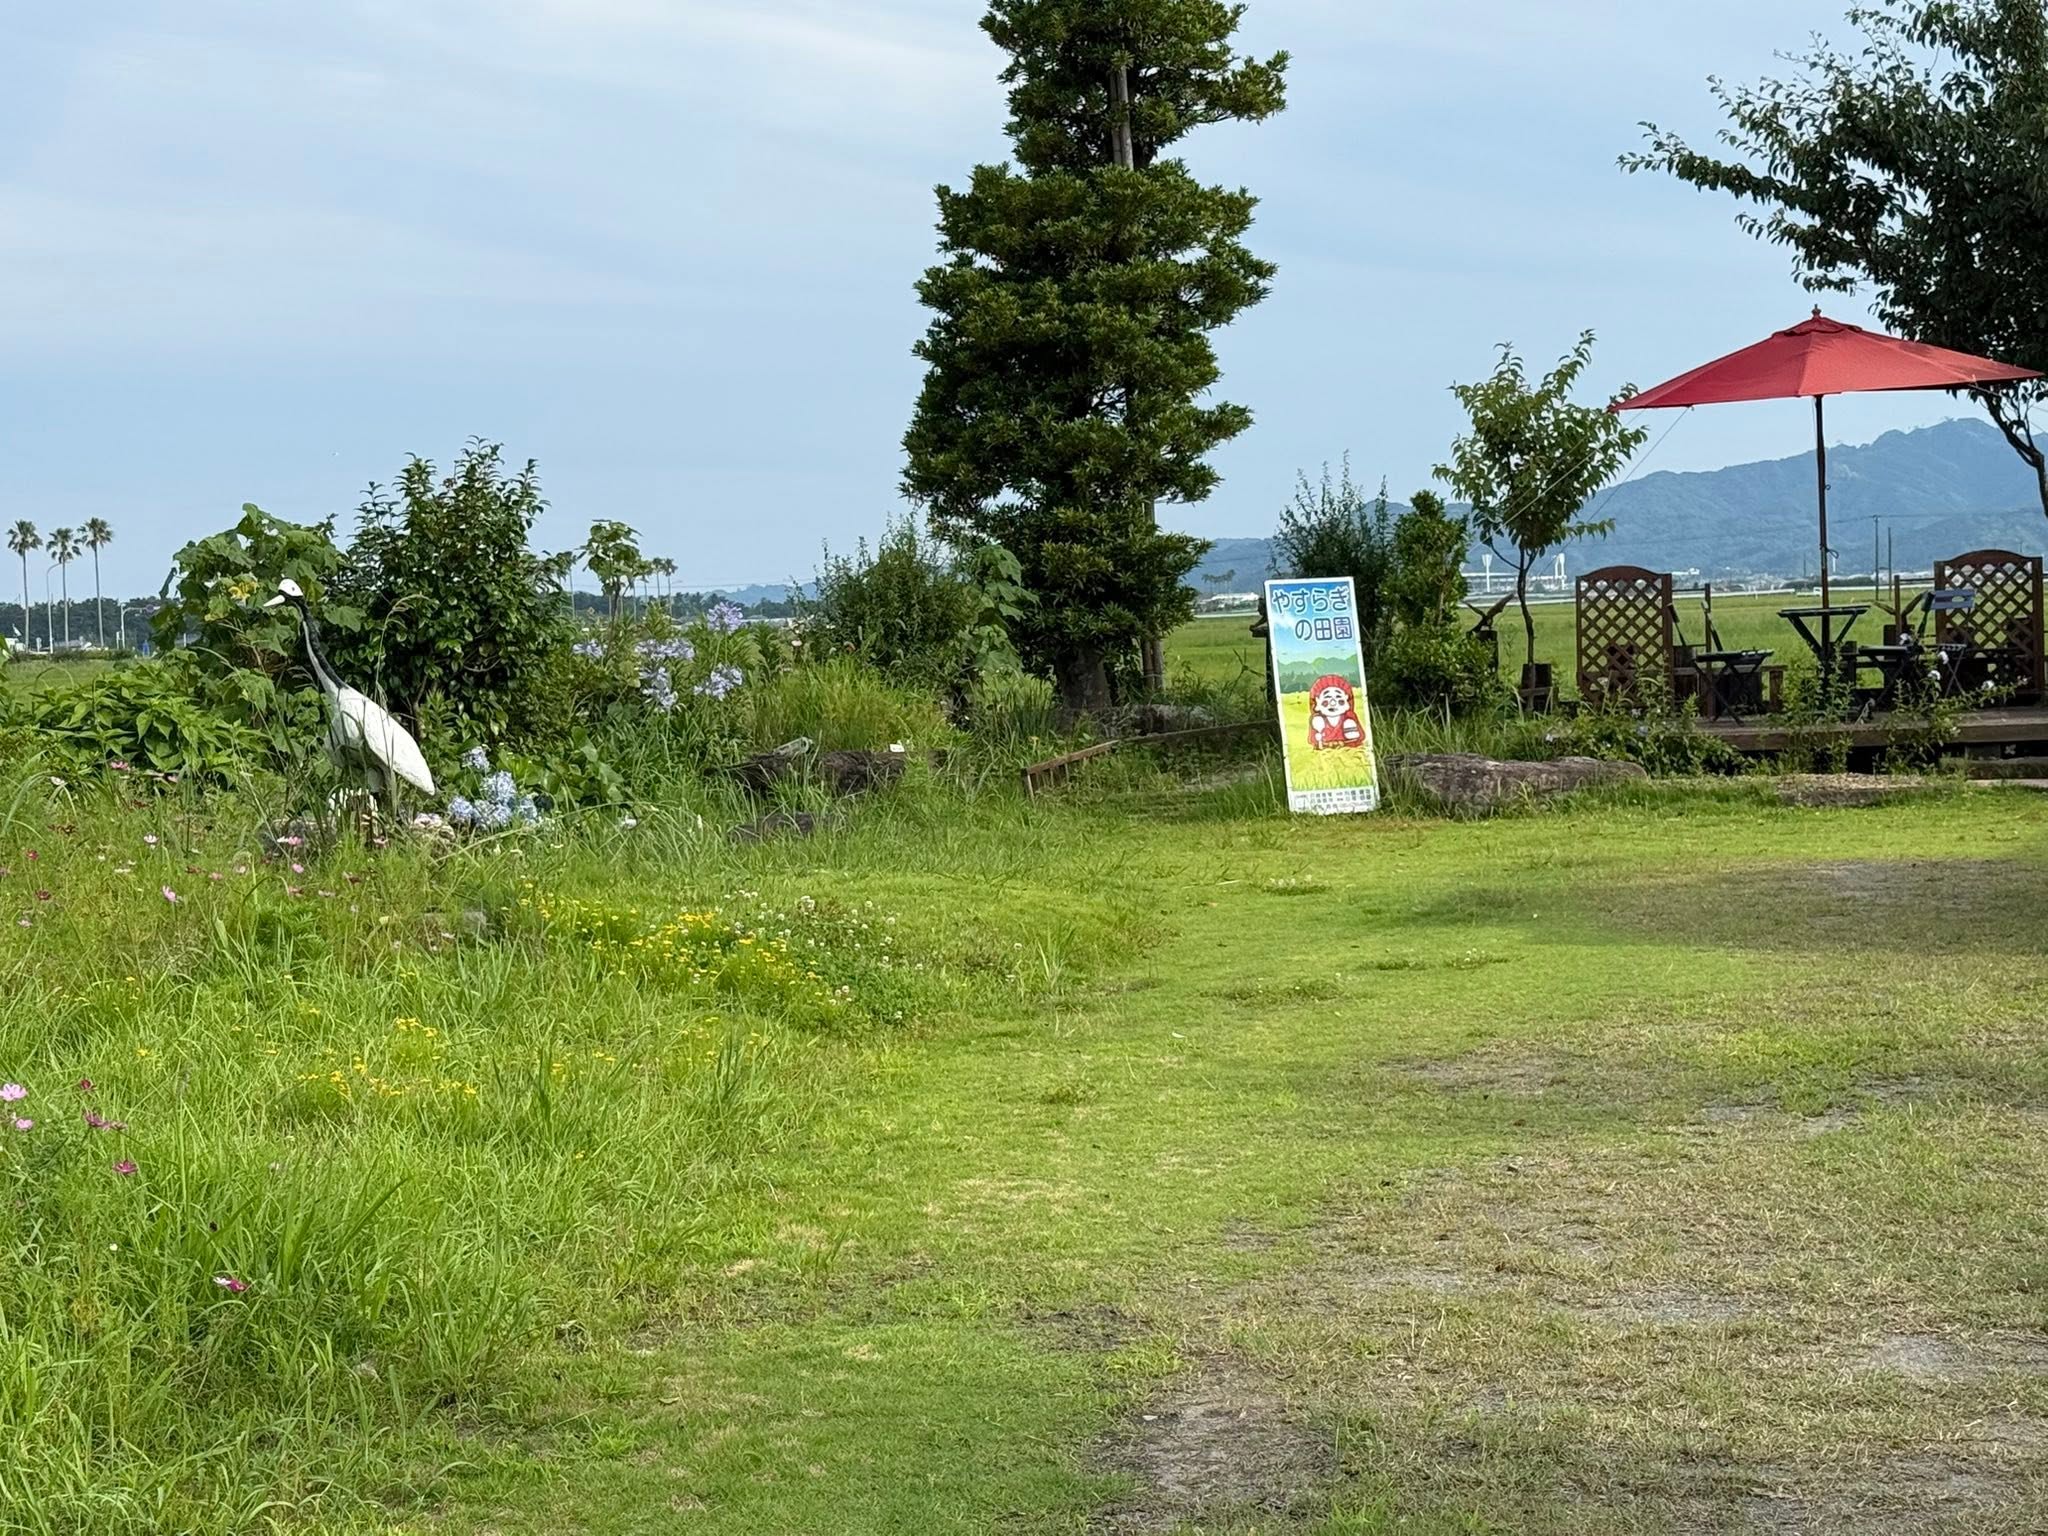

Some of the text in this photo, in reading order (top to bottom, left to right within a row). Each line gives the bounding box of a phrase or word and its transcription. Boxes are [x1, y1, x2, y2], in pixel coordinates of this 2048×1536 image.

[1272, 586, 1349, 614] やすらぎ
[1295, 617, 1353, 641] の田園
